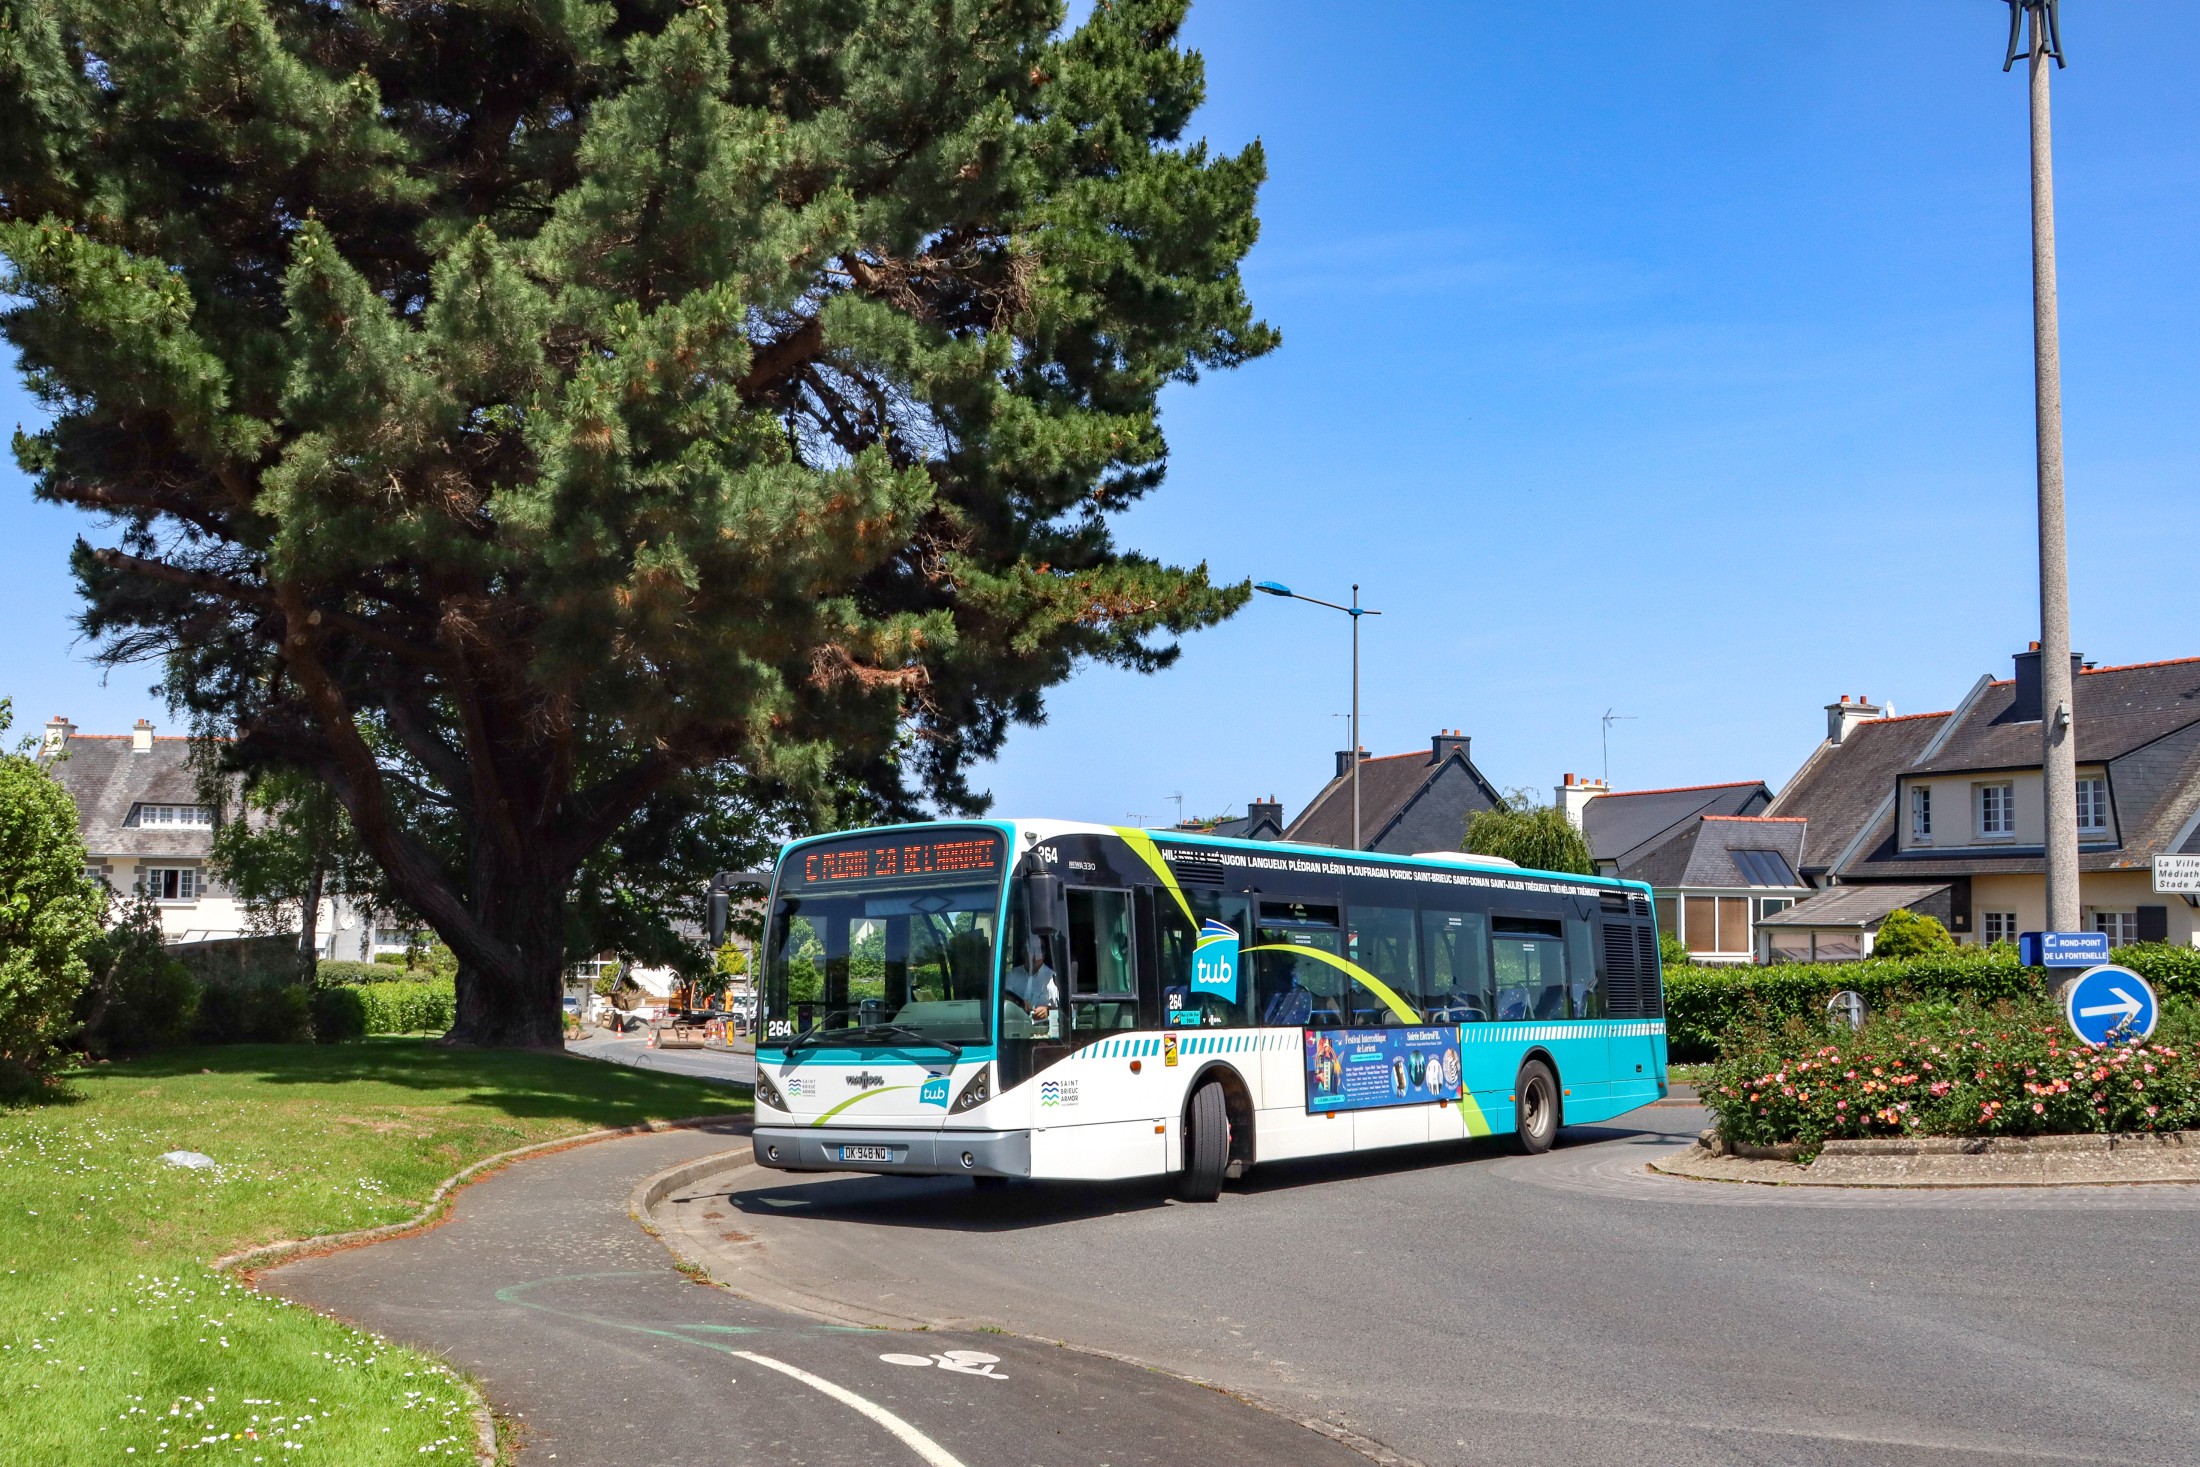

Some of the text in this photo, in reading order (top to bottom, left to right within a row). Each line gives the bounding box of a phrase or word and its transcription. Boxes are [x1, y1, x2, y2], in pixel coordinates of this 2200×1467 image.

[1038, 845, 1059, 864] 264
[2176, 860, 2200, 868] Ville
[1248, 856, 1289, 870] LANGUEUX
[1289, 858, 1321, 873] PLÉDRAN
[1322, 861, 1347, 875] PLÉRIN
[1347, 865, 1390, 879] PLOUFRAGAN
[1390, 869, 1413, 881] PORDIC
[1413, 871, 1453, 884] SAINT-BRIEUC
[1453, 874, 1490, 888] SAINT-DONAN
[1490, 878, 1525, 891] SAINT-JULIEN
[1524, 880, 1551, 893] TRÉGUEUX
[2158, 870, 2200, 878] Médiath
[2159, 880, 2189, 888] Stade
[2060, 939, 2101, 947] ROND-POINT
[2045, 951, 2107, 960] DE LA FONTENELLE
[1197, 954, 1233, 984] tub
[1169, 994, 1183, 1010] 264
[768, 1020, 792, 1037] 264
[923, 1086, 946, 1100] tub
